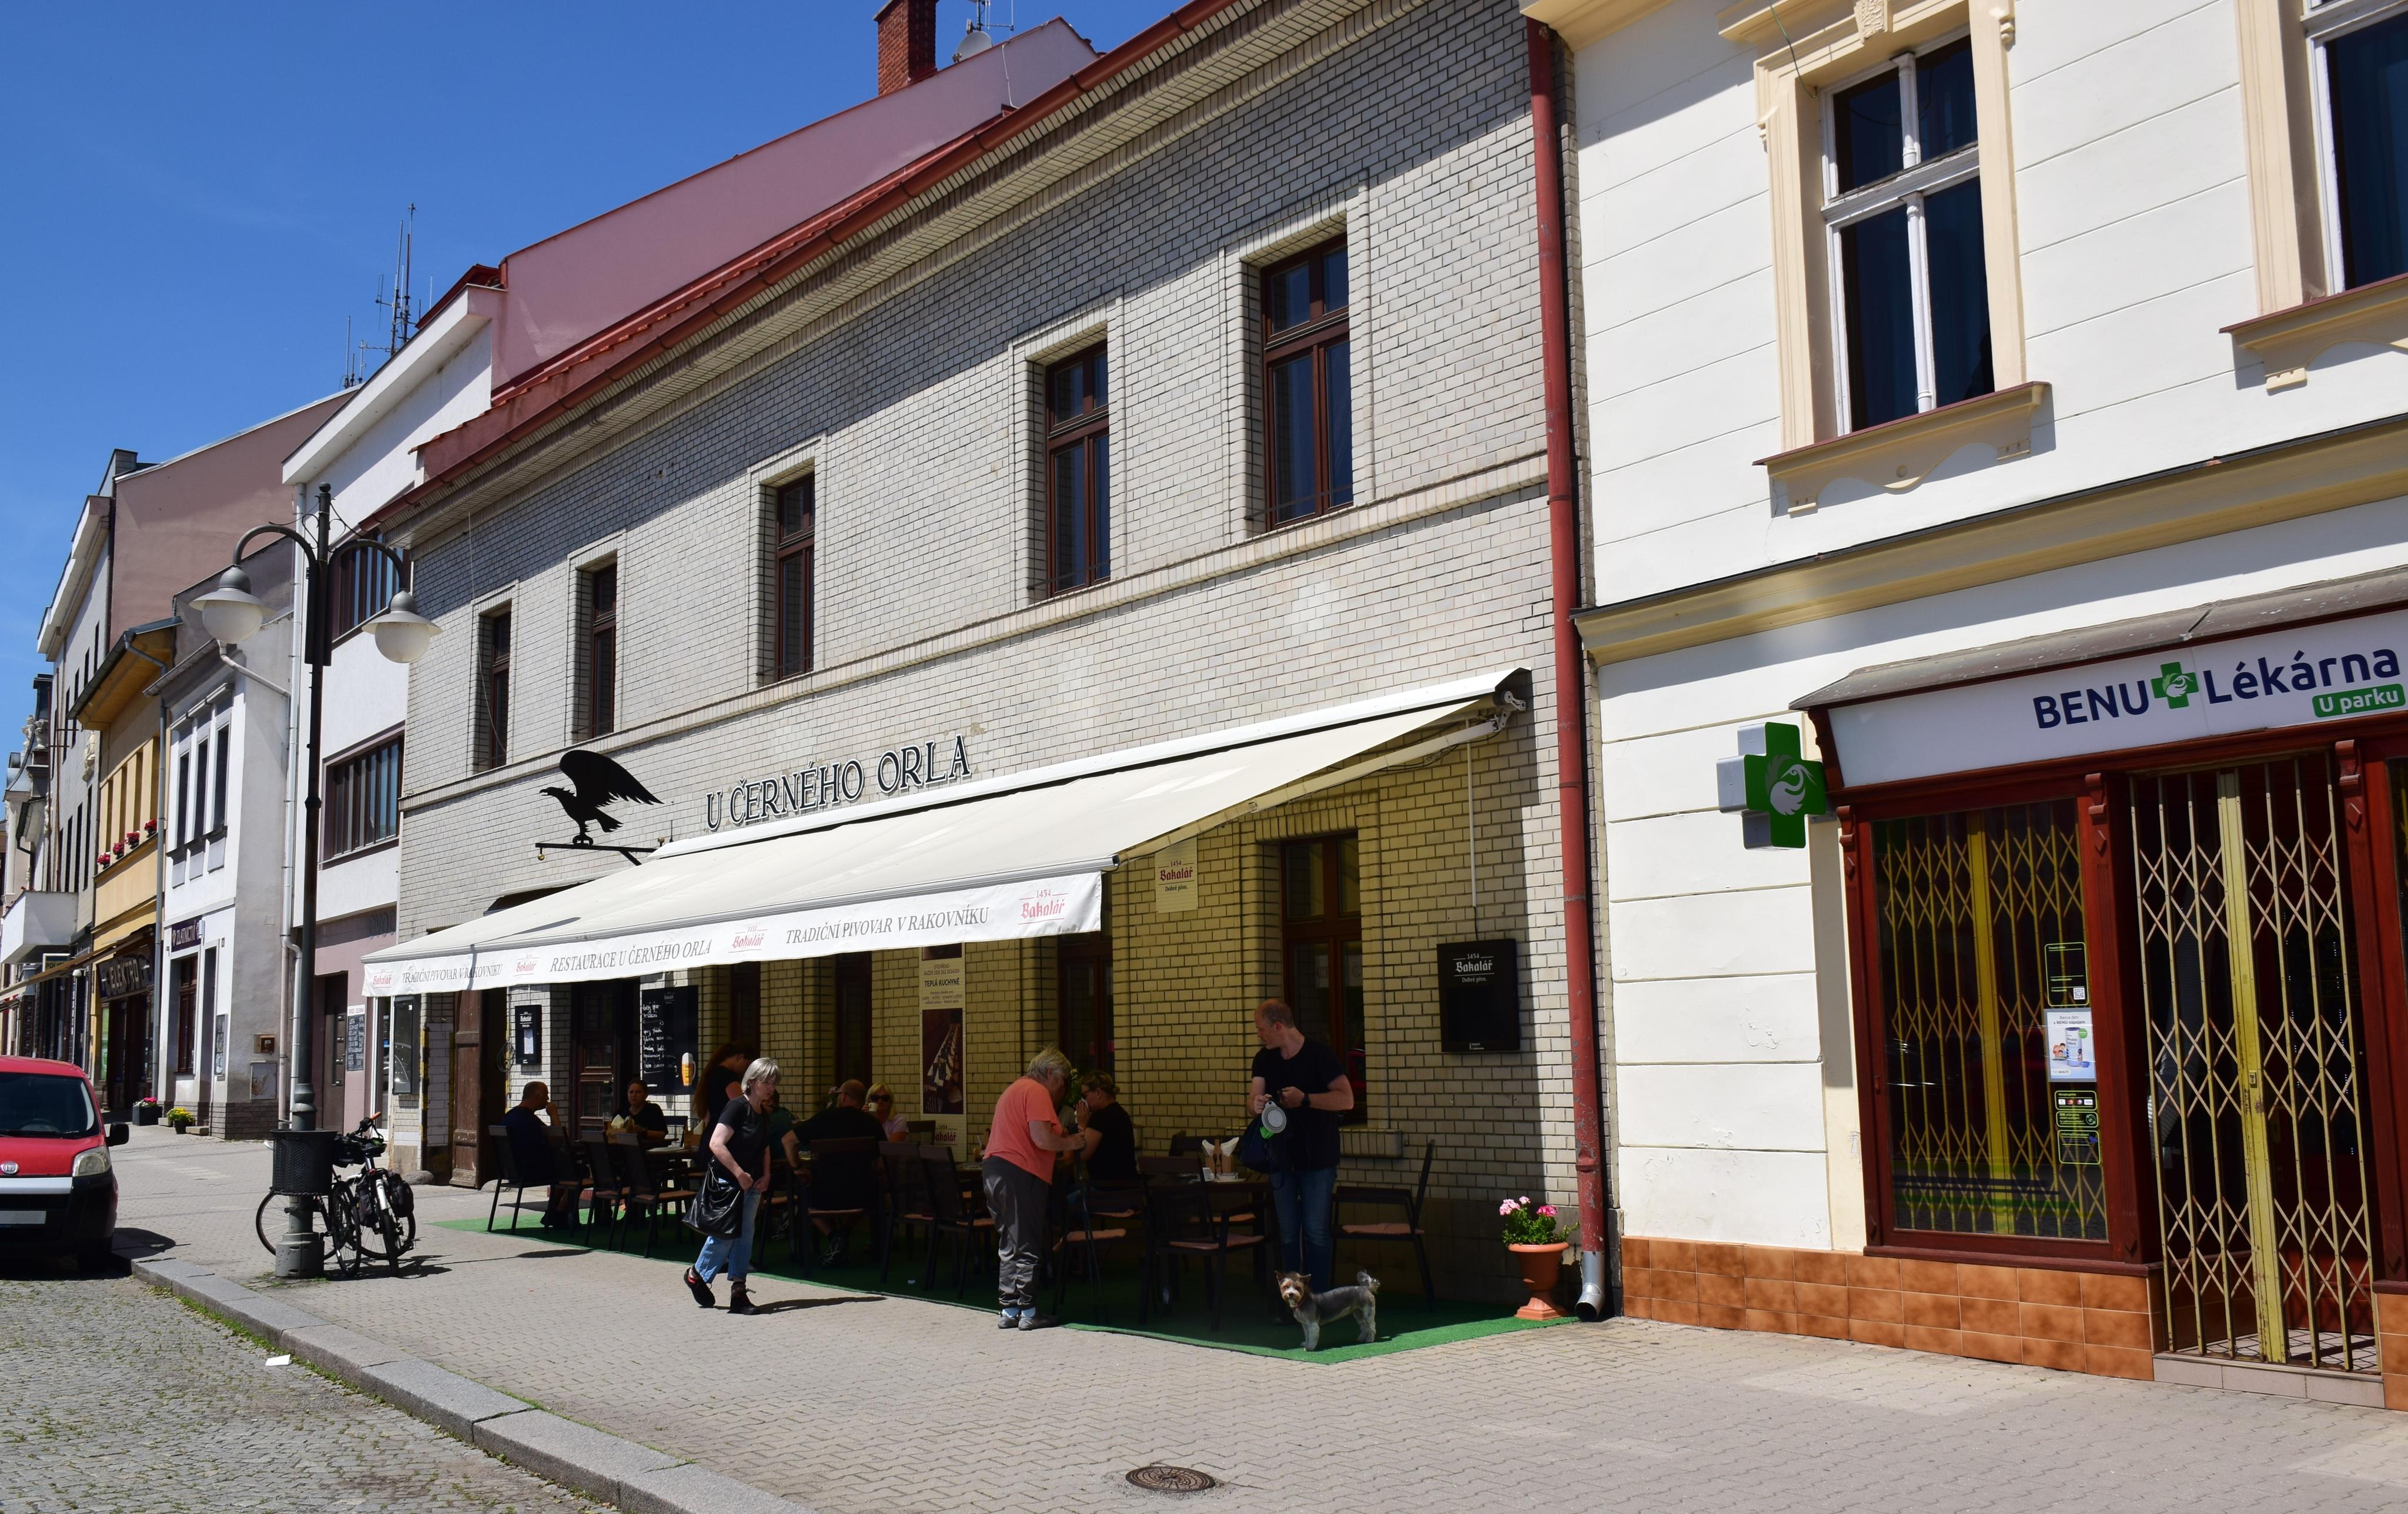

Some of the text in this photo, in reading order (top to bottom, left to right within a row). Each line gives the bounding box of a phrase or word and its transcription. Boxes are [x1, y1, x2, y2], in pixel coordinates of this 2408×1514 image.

[2033, 649, 2400, 729] BENU Lékárna
[2319, 688, 2399, 714] U parku
[705, 733, 972, 830] U ČERNÉHO ORLA
[1159, 866, 1193, 881] Bakalář
[1036, 889, 1051, 899] 1454
[1021, 899, 1065, 919] Bakalář
[785, 904, 990, 944] TRADIČNÍ PIVOVAR V RAKOVNÍKU
[550, 939, 713, 973] RESTAURACE U ČERNÉHO ORLA
[109, 959, 139, 989] ELEKTRO
[430, 969, 458, 981] PIVOVAR
[1455, 960, 1493, 973] Bakalář
[925, 978, 938, 987] TEPLÁ
[935, 1132, 957, 1142] akalář
